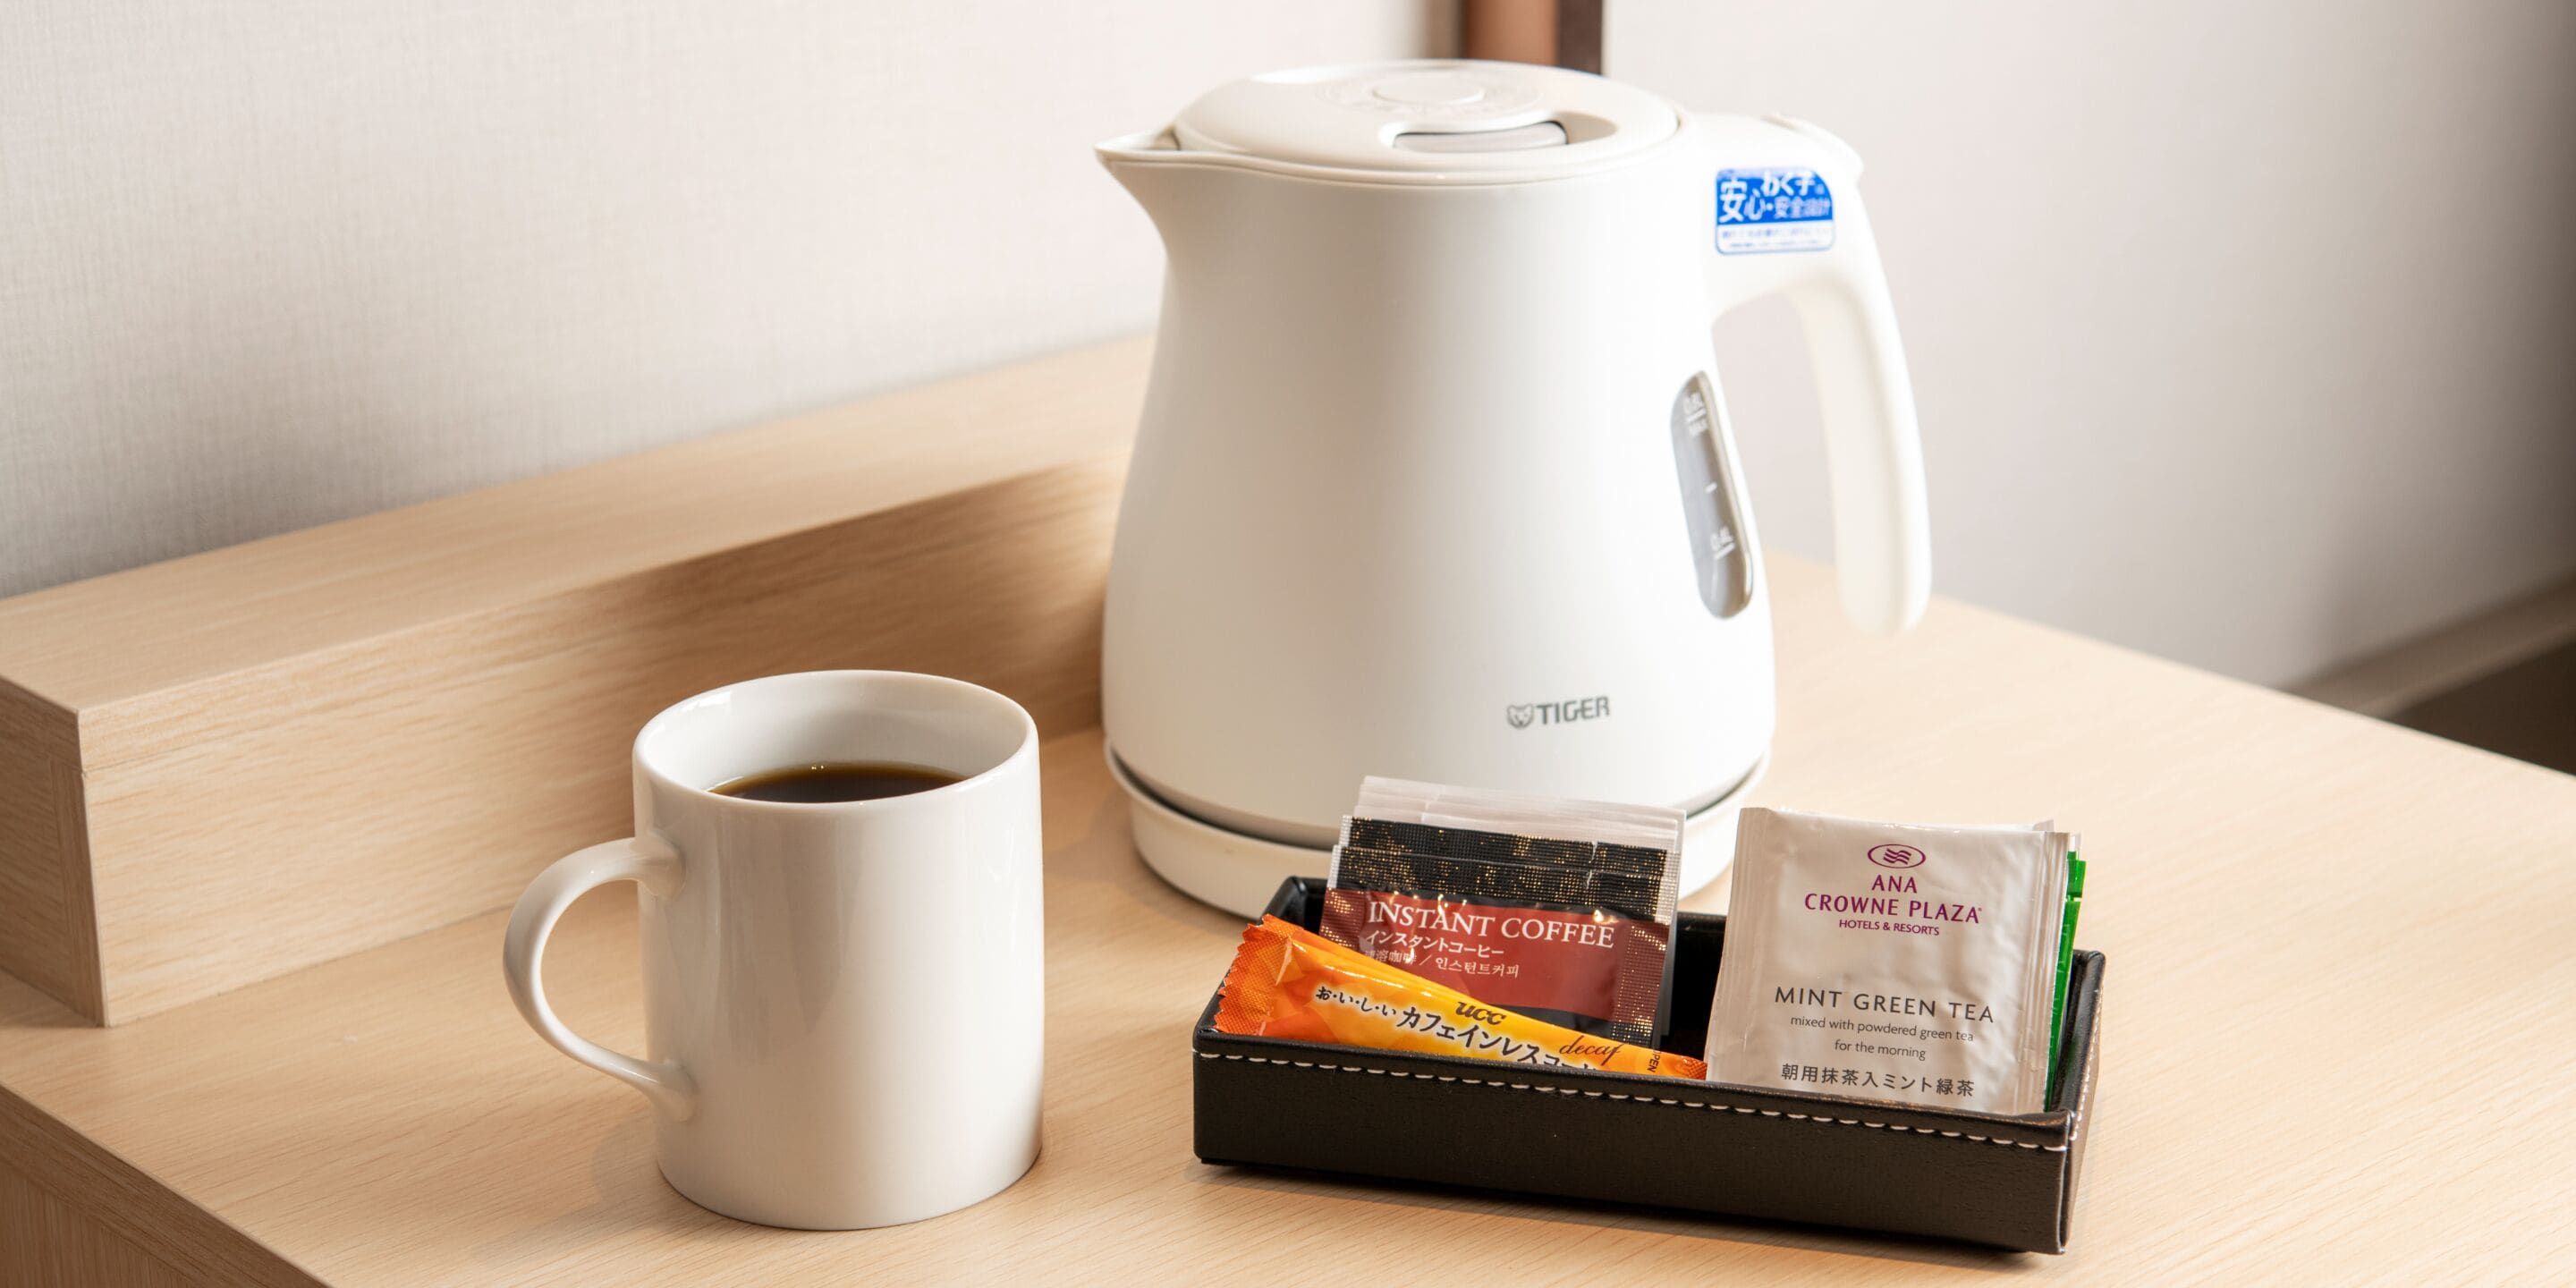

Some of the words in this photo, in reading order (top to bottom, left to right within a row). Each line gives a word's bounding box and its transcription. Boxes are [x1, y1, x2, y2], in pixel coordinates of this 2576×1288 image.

[1536, 696, 1610, 725] TIGER
[1871, 874, 1918, 894] ANA
[1804, 894, 1900, 917] CROWNE
[1368, 901, 1496, 937] INSTANT
[1501, 918, 1615, 949] COFFEE
[1839, 919, 1880, 931] HOTELS
[1882, 921, 1891, 931] &
[1893, 923, 1940, 936] RESORTS
[1366, 929, 1505, 959] インスタントコーヒー
[1435, 957, 1520, 979] 인스턴트커피
[1775, 987, 1843, 1009] MINT
[1853, 993, 1936, 1017] GREEN
[1948, 1002, 1995, 1023] TEA
[1791, 1015, 1826, 1029] mixed
[1829, 1019, 1854, 1030] with
[1857, 1022, 1918, 1037] powdered
[1920, 1028, 1953, 1041] green
[1956, 1030, 1974, 1042] tea
[1559, 1035, 1625, 1066] decaf
[1835, 1039, 1852, 1052] for
[1855, 1041, 1875, 1054] the
[1877, 1046, 1927, 1062] morning
[1781, 1063, 1975, 1097] 朝用抹茶入ミント緑茶
